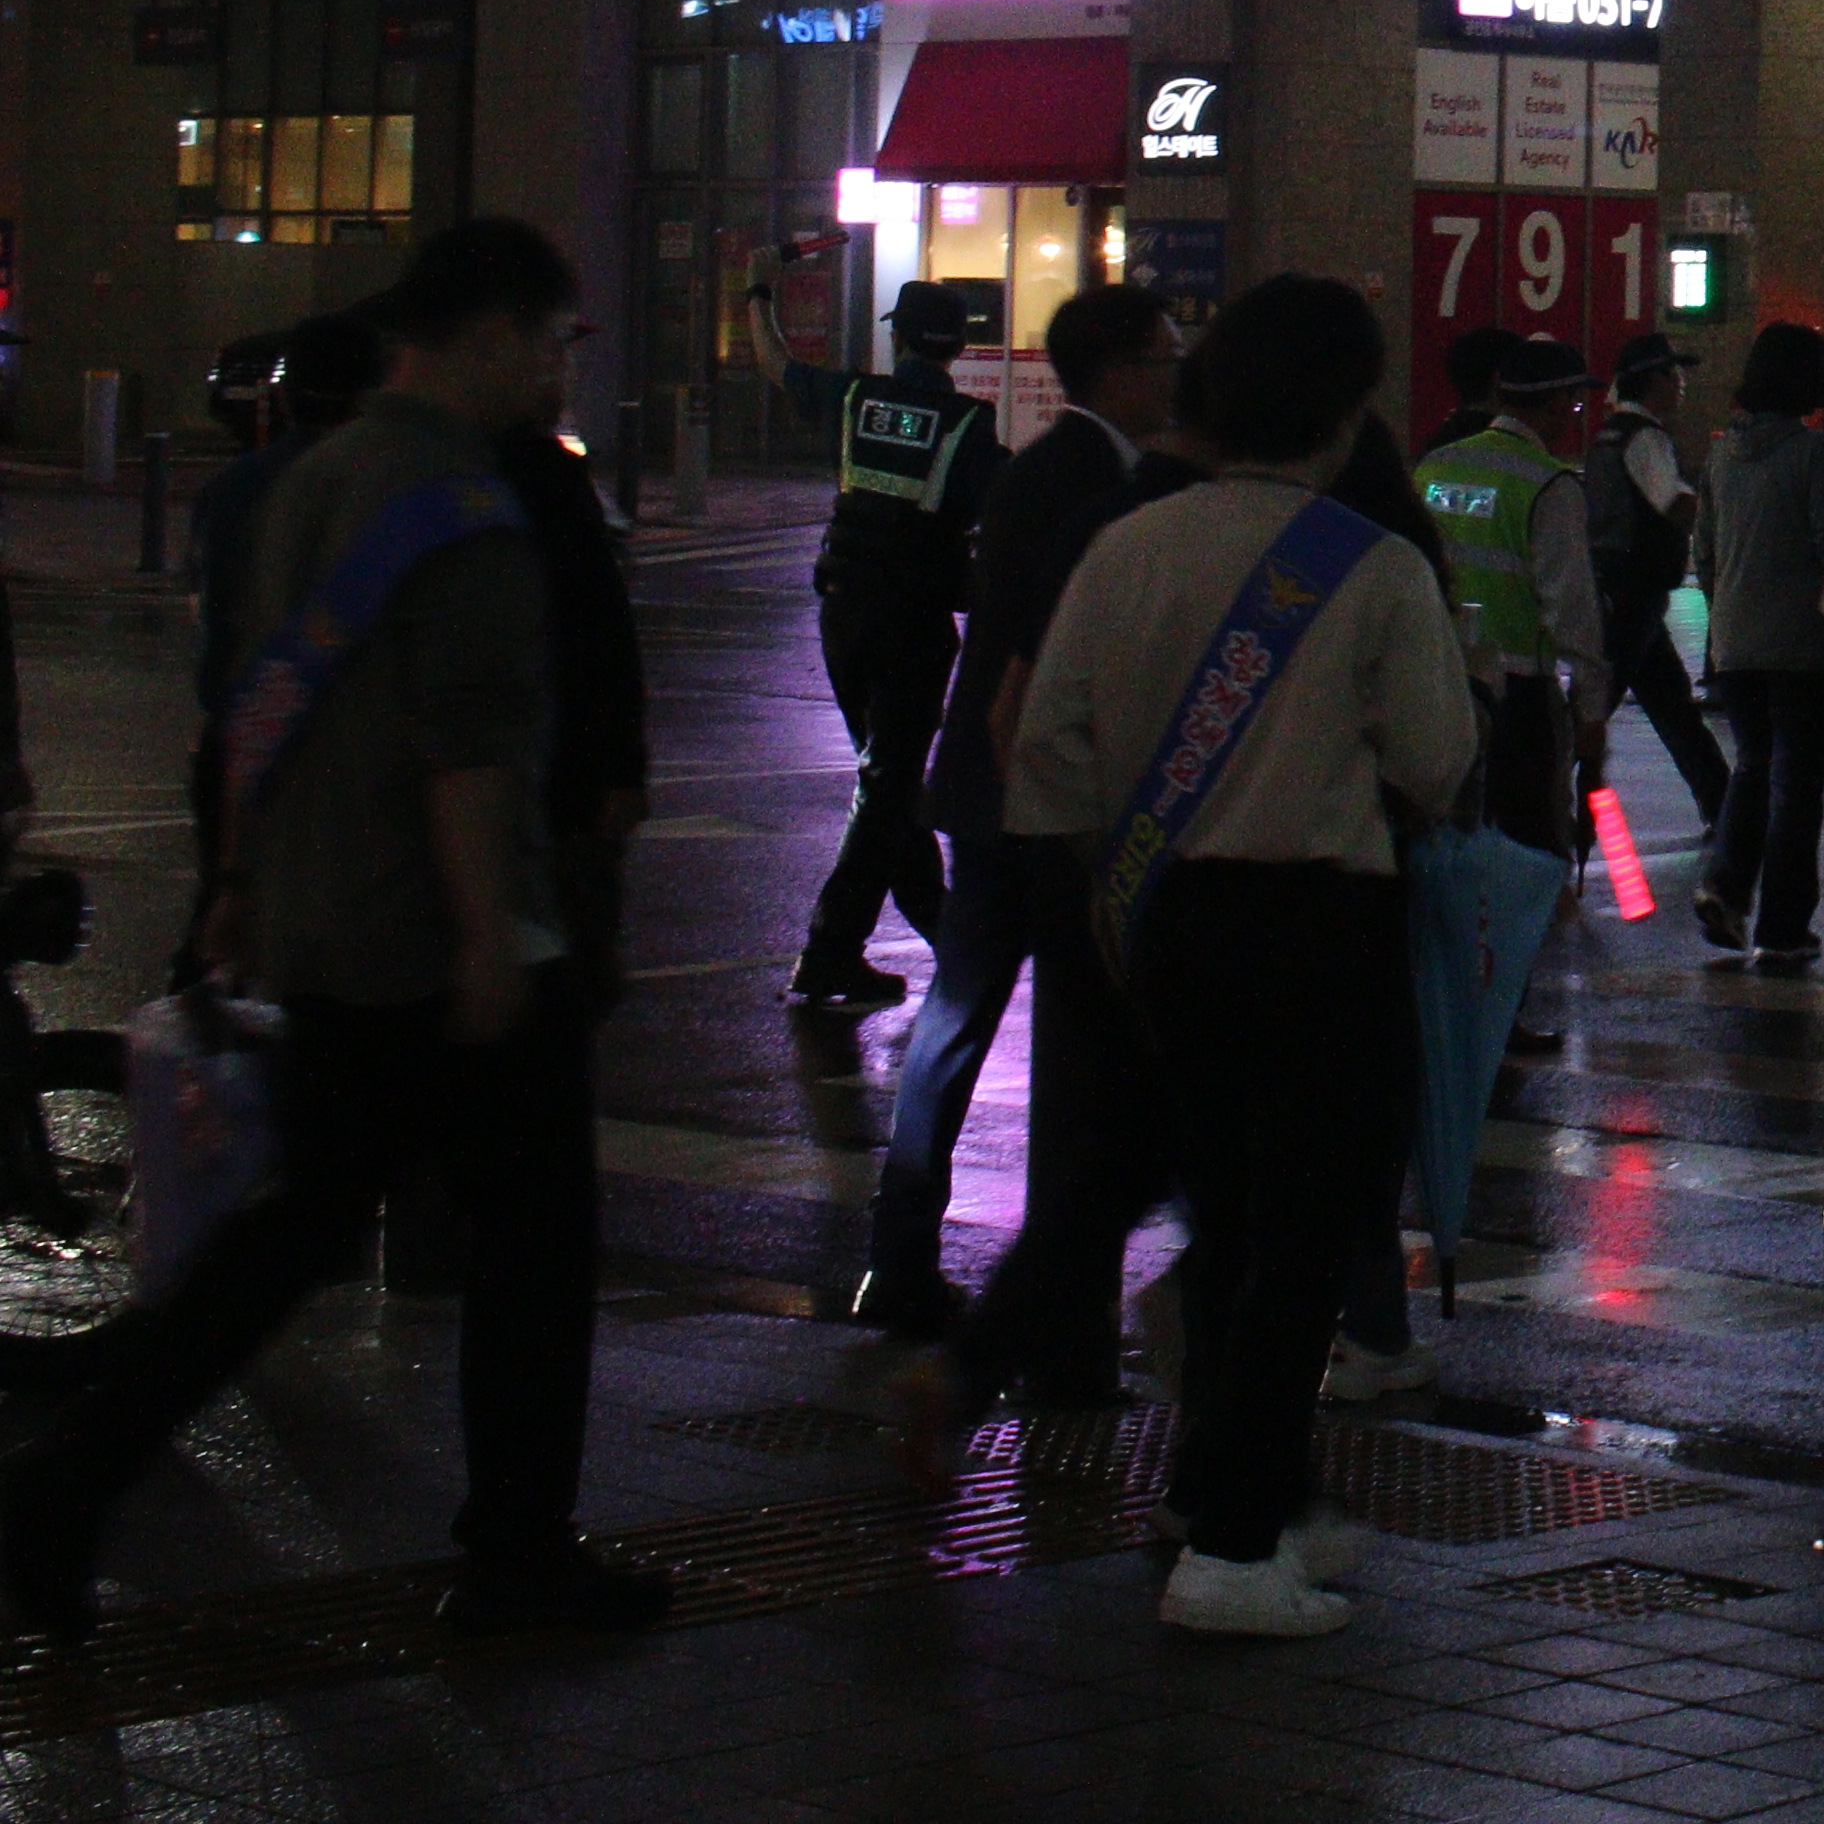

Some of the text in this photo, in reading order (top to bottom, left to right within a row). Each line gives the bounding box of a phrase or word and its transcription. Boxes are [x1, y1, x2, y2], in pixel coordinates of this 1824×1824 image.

[1430, 92, 1482, 115] English
[1524, 96, 1567, 115] Estate
[1422, 119, 1488, 139] Available
[1514, 122, 1577, 141] Licensed
[1141, 134, 1219, 159] 힐스테이트
[1519, 148, 1572, 171] Agency
